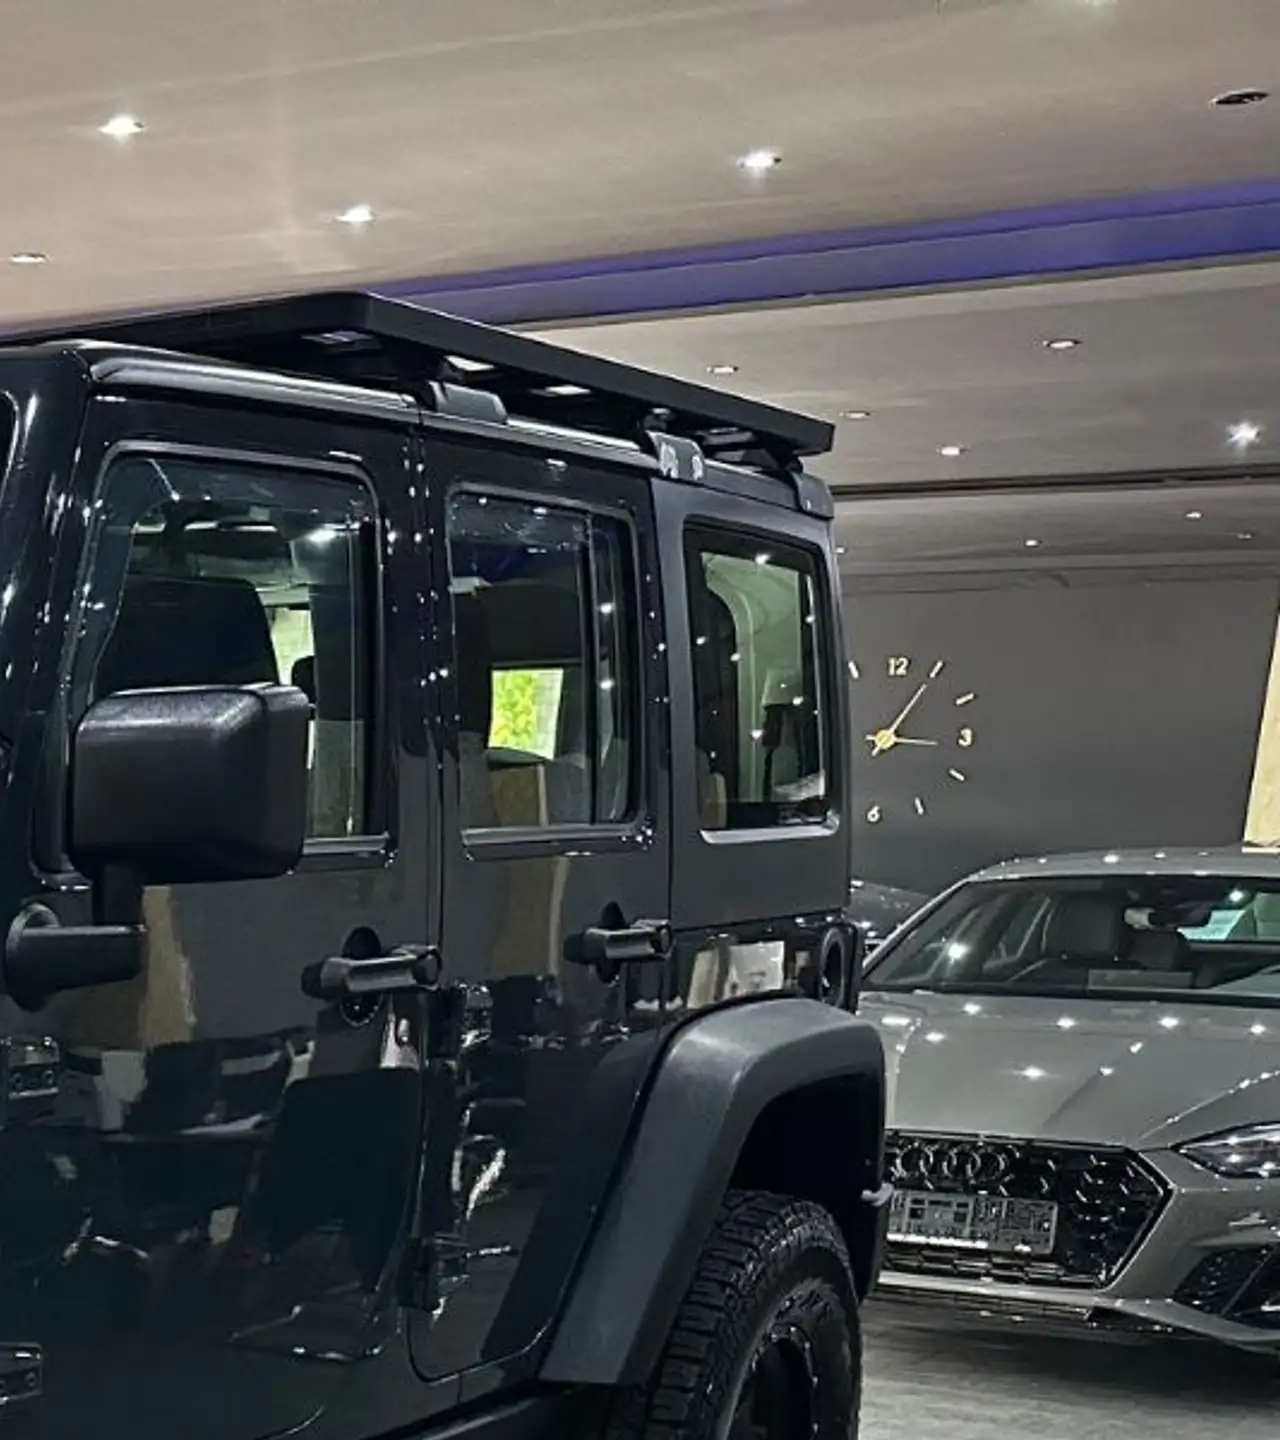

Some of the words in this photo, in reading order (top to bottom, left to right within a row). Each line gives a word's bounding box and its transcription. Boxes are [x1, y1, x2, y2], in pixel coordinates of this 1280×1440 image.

[888, 656, 909, 676] 12
[958, 728, 973, 747] 3
[866, 804, 882, 823] 6
